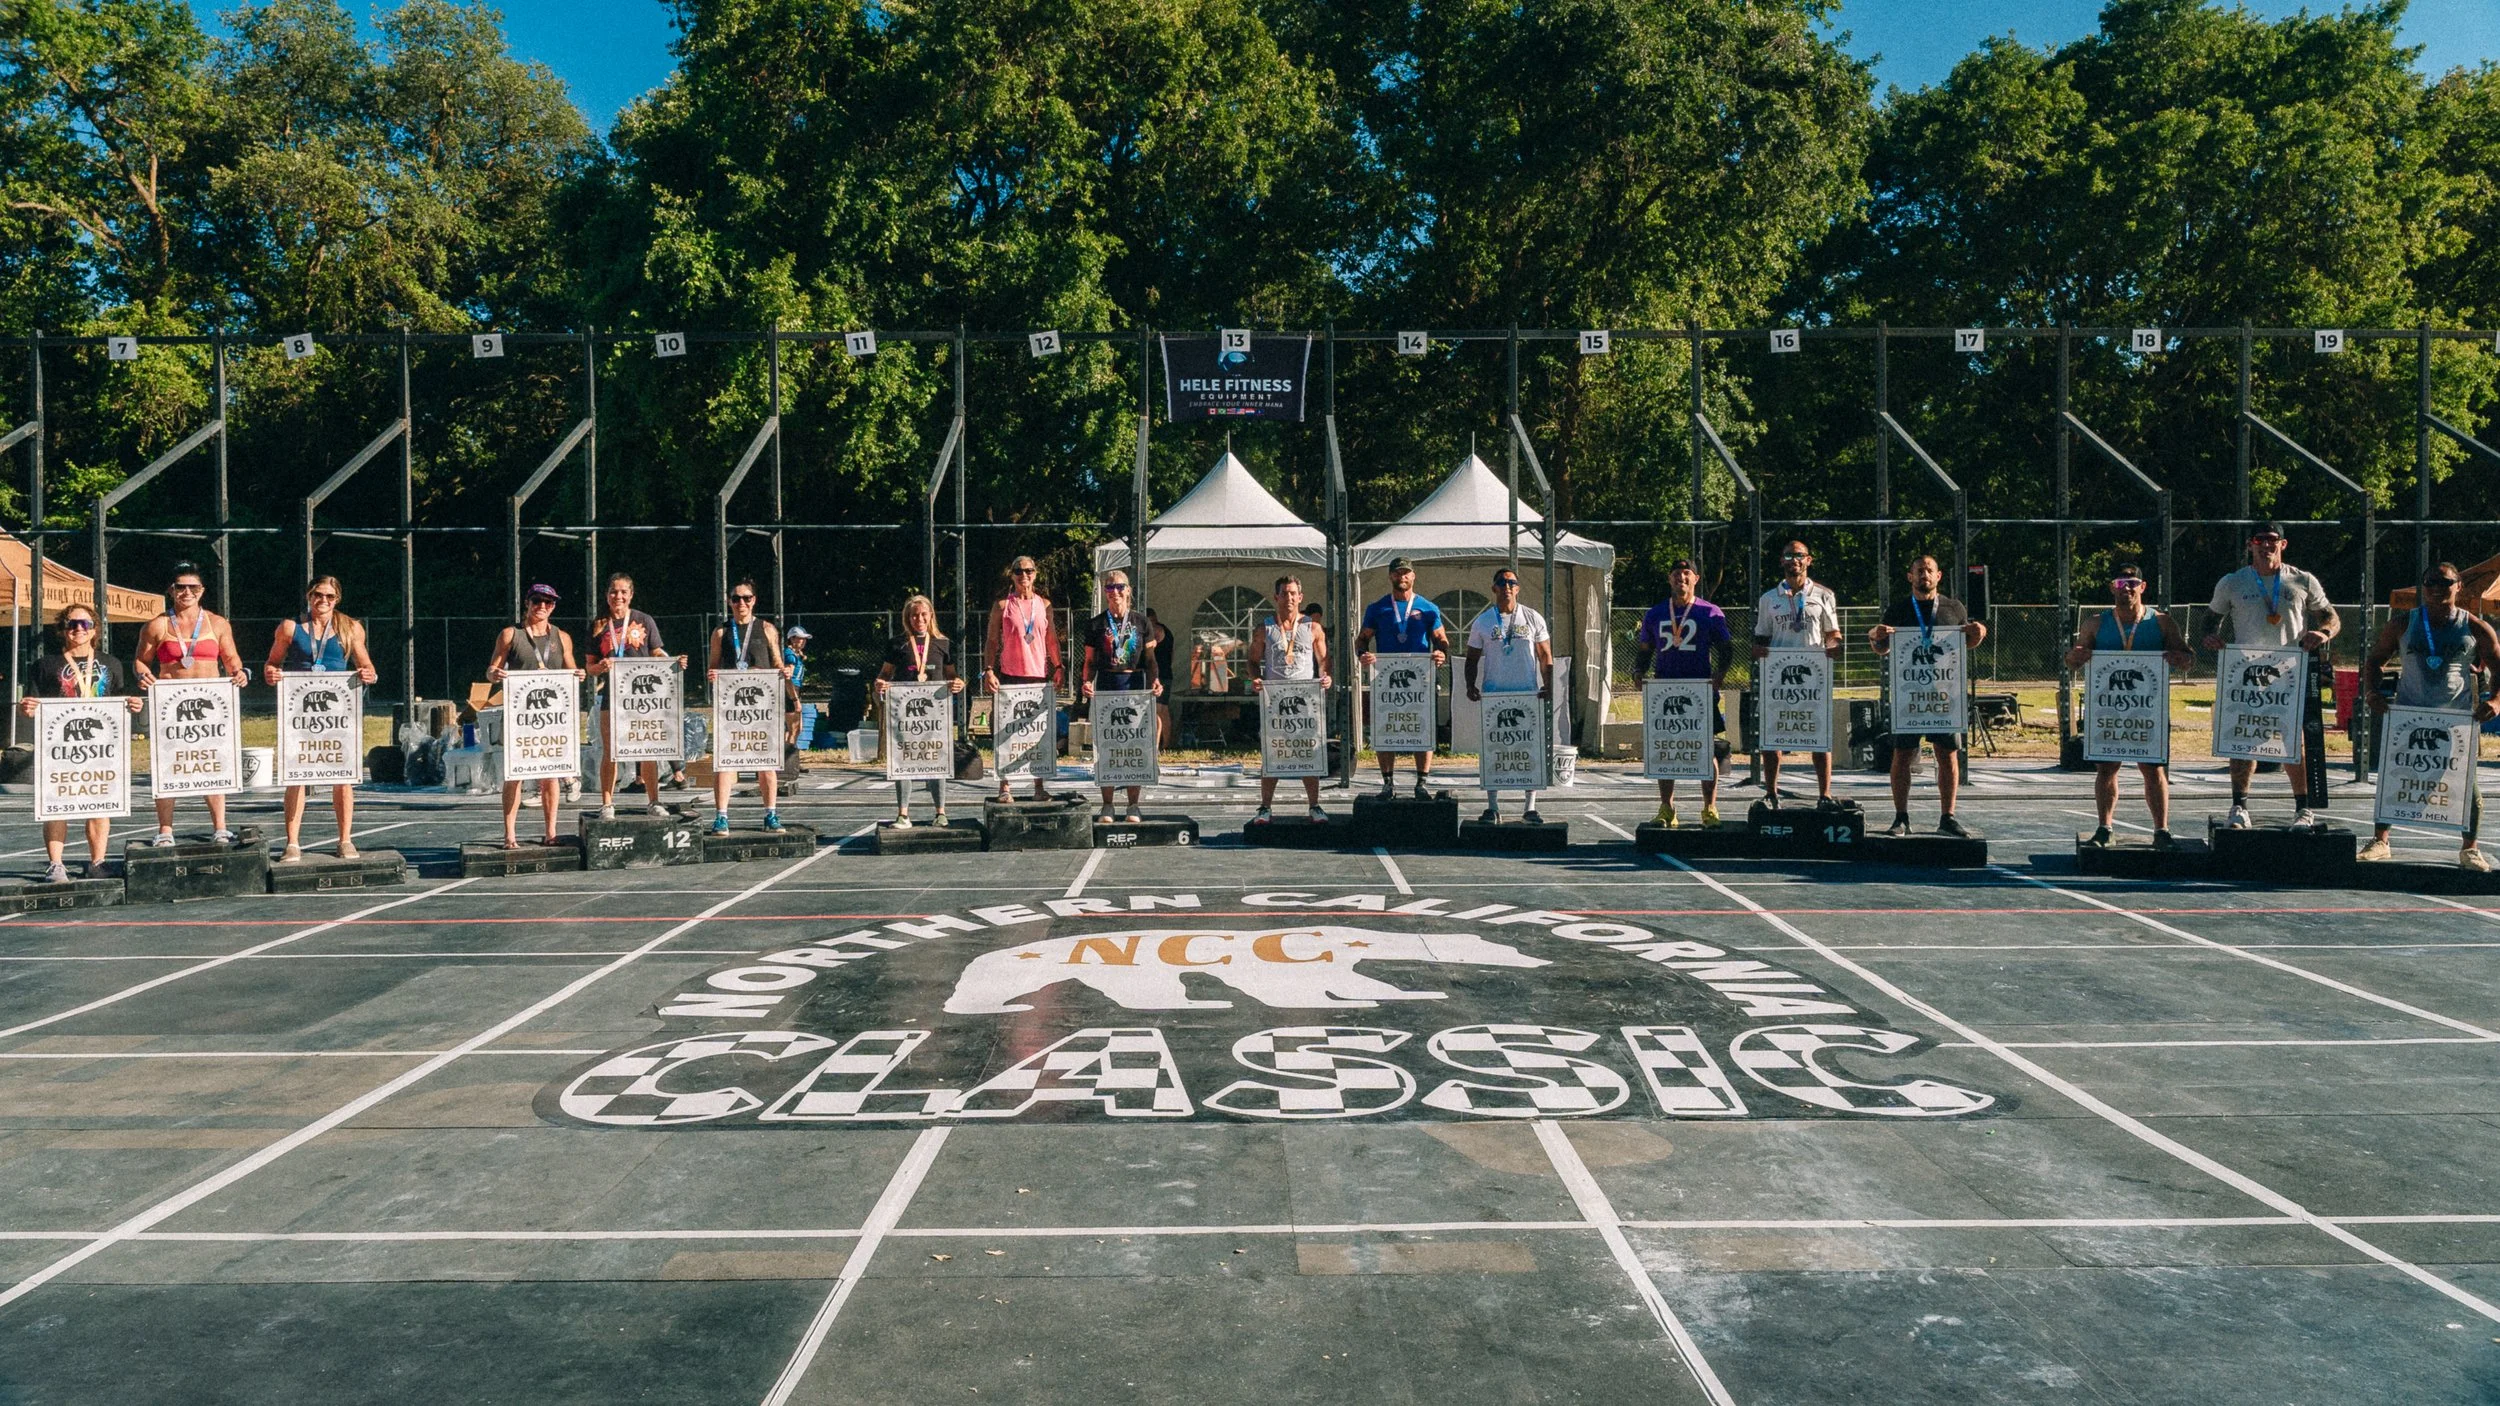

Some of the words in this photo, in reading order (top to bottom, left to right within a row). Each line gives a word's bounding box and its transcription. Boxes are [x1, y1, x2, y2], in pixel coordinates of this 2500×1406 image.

[294, 340, 305, 353] 8
[482, 339, 493, 353] 9
[660, 338, 679, 352] 10
[853, 337, 867, 350] 11
[1035, 336, 1054, 351] 12
[1227, 334, 1244, 347] 13
[1403, 336, 1422, 349] 14
[1585, 335, 1603, 349] 15
[1776, 334, 1794, 347] 16
[1960, 334, 1978, 347] 17
[2137, 333, 2155, 347] 18
[2320, 335, 2337, 348] 19
[118, 343, 127, 355] 7
[1180, 379, 1220, 392] HELE
[1225, 379, 1292, 392] FITNESS
[1659, 619, 1697, 652] 52
[1903, 668, 1954, 685] CLASSIC
[2114, 671, 2132, 681] NCC
[2249, 666, 2268, 677] NCC
[636, 676, 653, 686] NCC
[307, 692, 326, 703] NCC
[531, 689, 547, 700] NCC
[739, 688, 755, 698] NCC
[1381, 691, 1425, 707] CLASSIC
[1771, 688, 1821, 704] CLASSIC
[1909, 692, 1948, 702] THIRD
[2230, 689, 2290, 708] CLASSIC
[182, 700, 201, 711] NCC
[622, 697, 672, 714] CLASSIC
[1909, 703, 1950, 714] PLACE
[2098, 694, 2154, 712] CLASSIC
[516, 712, 567, 730] CLASSIC
[725, 708, 773, 725] CLASSIC
[1388, 712, 1419, 722] FIRST
[1779, 711, 1814, 720] FIRST
[2238, 714, 2280, 727] FIRST
[69, 719, 90, 731] NCC
[292, 716, 348, 734] CLASSIC
[630, 720, 664, 730] FIRST
[897, 720, 942, 736] CLASSIC
[1005, 721, 1047, 737] CLASSIC
[1271, 718, 1315, 733] CLASSIC
[1385, 723, 1421, 733] PLACE
[1655, 718, 1702, 734] CLASSIC
[1777, 721, 1816, 732] PLACE
[2097, 718, 2155, 729] SECOND
[166, 724, 226, 743] CLASSIC
[628, 732, 667, 742] PLACE
[731, 731, 767, 741] THIRD
[1103, 728, 1147, 743] CLASSIC
[1489, 730, 1534, 746] CLASSIC
[2103, 731, 2148, 742] PLACE
[2234, 727, 2282, 740] PLACE
[2416, 729, 2436, 740] NCC
[299, 740, 342, 751] THIRD
[516, 735, 568, 747] SECOND
[730, 742, 768, 752] PLACE
[897, 741, 943, 751] SECOND
[1011, 742, 1040, 751] FIRST
[1271, 739, 1317, 749] SECOND
[1654, 740, 1703, 750] SECOND
[51, 745, 115, 764] CLASSIC
[176, 749, 218, 761] FIRST
[522, 748, 563, 759] PLACE
[1109, 748, 1143, 758] THIRD
[1277, 749, 1312, 759] PLACE
[1862, 744, 1874, 761] 12
[2231, 744, 2258, 752] 35-39
[2260, 746, 2282, 754] MEN
[298, 753, 343, 764] PLACE
[903, 751, 938, 761] PLACE
[1009, 752, 1043, 762] PLACE
[1495, 751, 1530, 761] THIRD
[1660, 751, 1698, 761] PLACE
[2395, 752, 2459, 773] CLASSIC
[173, 762, 222, 775] PLACE
[512, 765, 537, 773] 40-44
[540, 763, 572, 771] WOMEN
[1109, 758, 1144, 768] PLACE
[1495, 762, 1530, 772] PLACE
[50, 770, 116, 784] SECOND
[58, 784, 109, 797] PLACE
[163, 781, 190, 790] 35-39
[193, 779, 231, 788] WOMEN
[2400, 778, 2449, 793] THIRD
[2397, 792, 2449, 807] PLACE
[47, 804, 75, 813] 35-39
[78, 802, 119, 811] WOMEN
[2394, 810, 2423, 818] 35-39
[2425, 813, 2448, 822] MEN
[599, 837, 634, 847] REP
[663, 831, 691, 848] 12
[1107, 833, 1137, 842] REP
[1178, 830, 1190, 845] 6
[1760, 825, 1793, 835] REP
[1823, 826, 1852, 843] 12
[658, 893, 1202, 1018] NORTHERN
[1240, 891, 1858, 1018] CALIFORNIA
[1059, 931, 1334, 967] NCC
[559, 1024, 1996, 1126] CLASSIC
